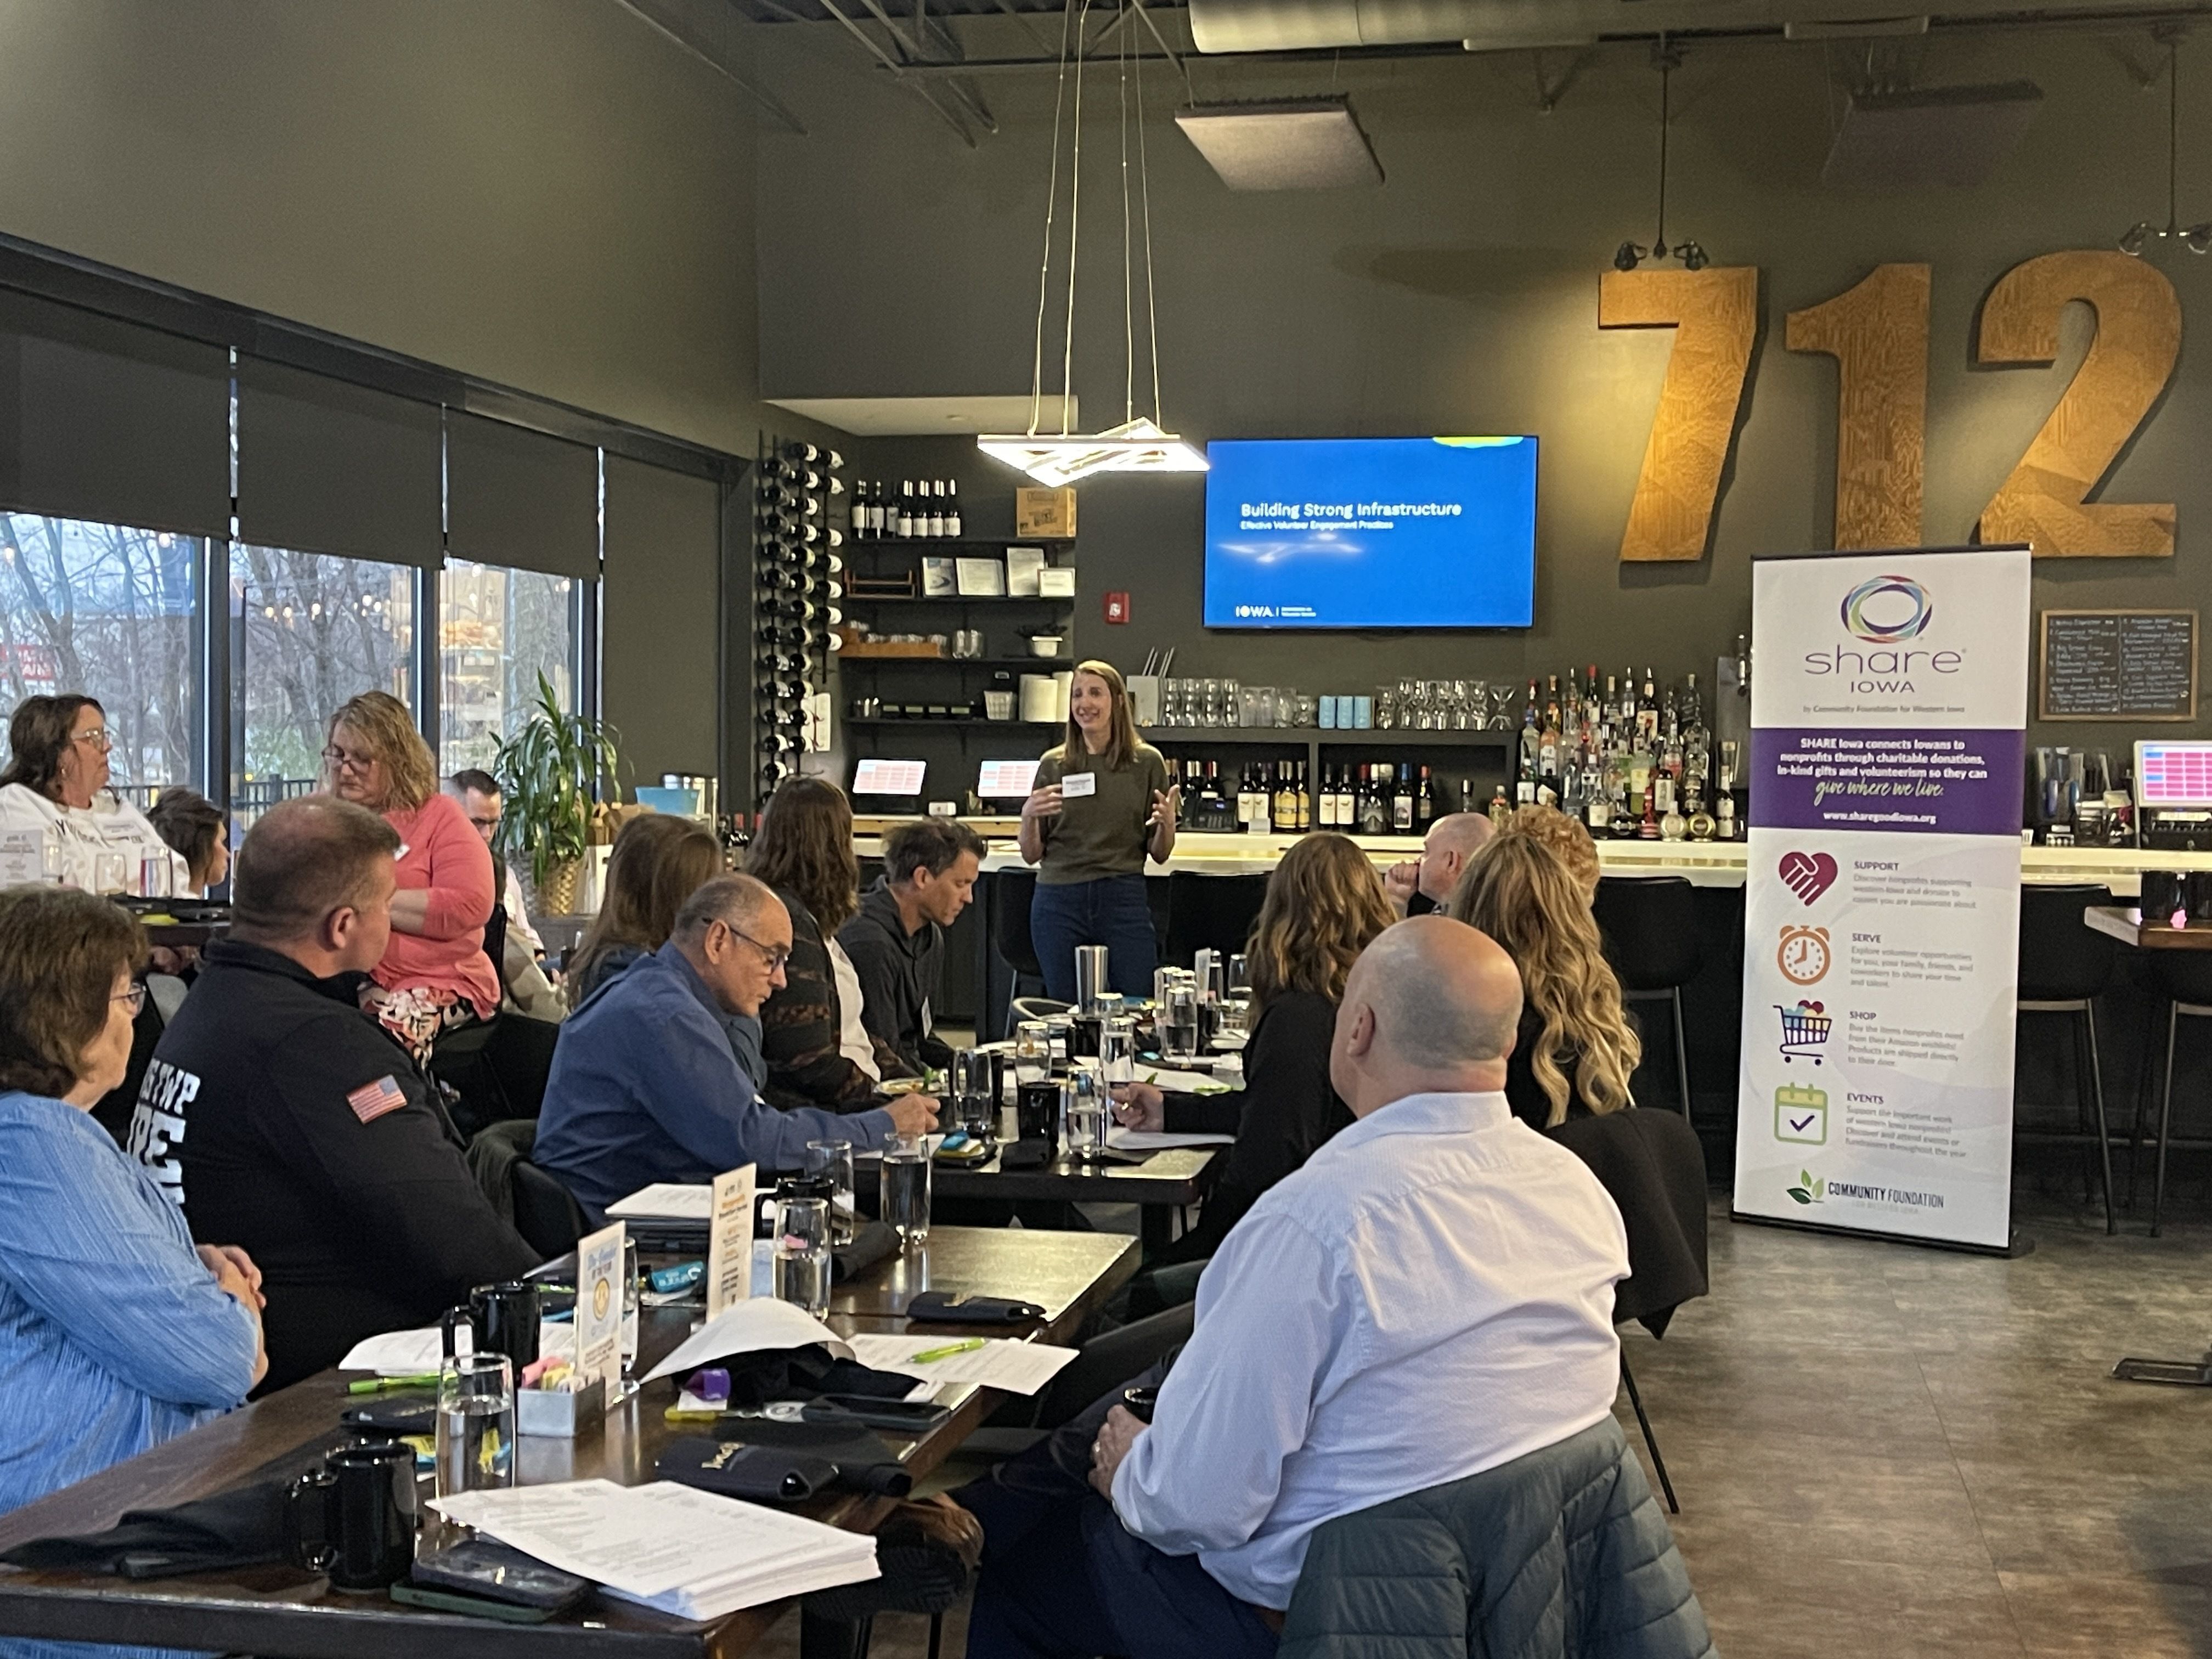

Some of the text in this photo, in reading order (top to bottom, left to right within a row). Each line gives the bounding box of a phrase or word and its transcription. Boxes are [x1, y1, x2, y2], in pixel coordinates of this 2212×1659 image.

[1599, 250, 2182, 561] 712
[1241, 502, 1462, 519] Building Strong Infrastructure
[1235, 605, 1274, 618] IOWA
[1805, 645, 1962, 674] share
[1851, 681, 1915, 693] IOWA
[1801, 738, 1965, 750] SHARE Iowa connects Iowans to
[1781, 752, 1985, 765] nonprofits through charitable donations,
[1815, 765, 1837, 777] gifts
[1839, 766, 1857, 776] and
[1860, 766, 1927, 778] volunteerism
[1929, 769, 1941, 777] so
[1944, 768, 1966, 780] they
[1968, 770, 1987, 778] can
[1814, 780, 1846, 806] give
[1848, 777, 1891, 796] where
[1893, 783, 1913, 795] we
[1854, 861, 1899, 871] SUPPORT
[1852, 933, 1881, 943] SERVE
[1849, 1011, 1876, 1020] SHOP
[1847, 1093, 1884, 1104] EVENTS
[1829, 1182, 1886, 1201] COMMUNITY
[1888, 1189, 1944, 1207] FOUNDATION
